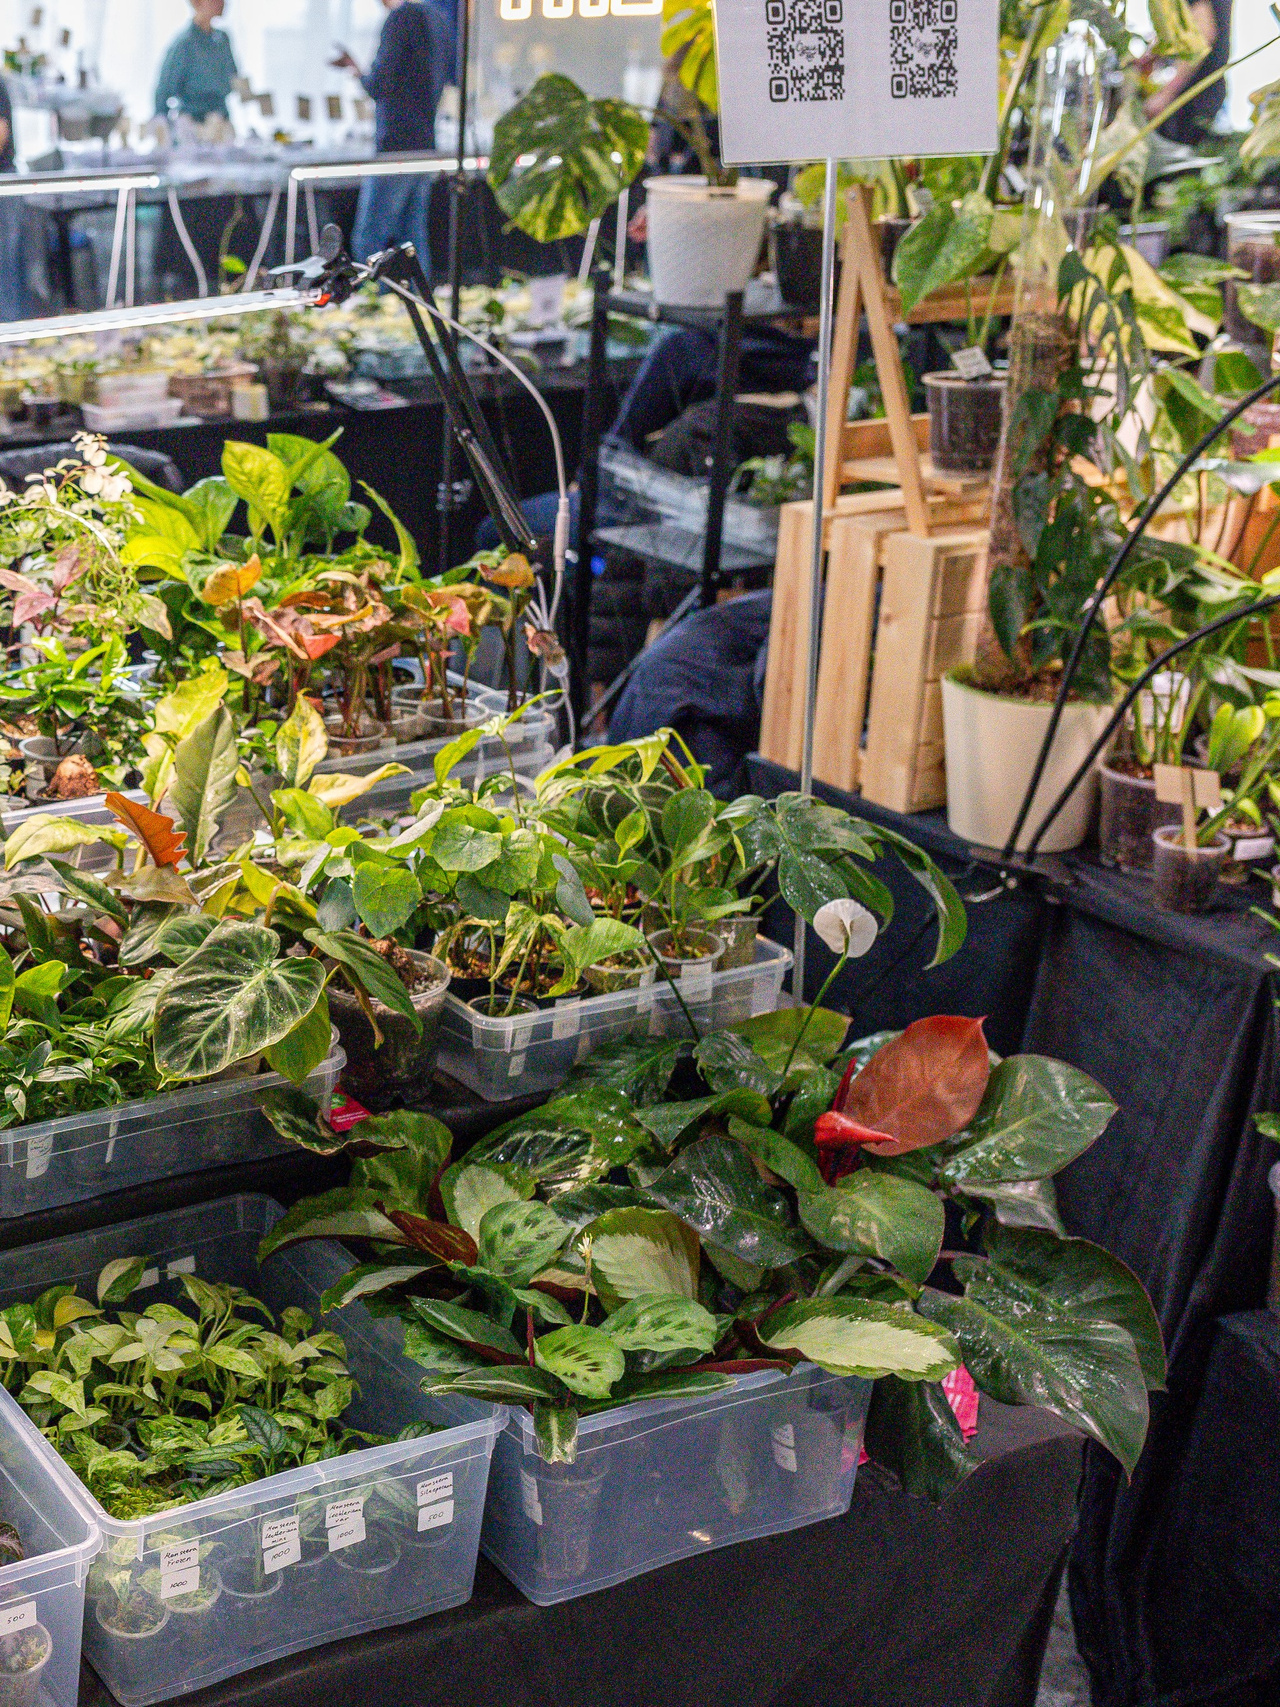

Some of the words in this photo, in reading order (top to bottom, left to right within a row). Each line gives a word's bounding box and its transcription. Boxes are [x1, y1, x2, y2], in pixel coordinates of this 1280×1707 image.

[428, 1511, 443, 1522] 500
[336, 1529, 354, 1540] 1000
[271, 1547, 290, 1561] 1000
[170, 1580, 188, 1589] 1000
[7, 1613, 25, 1624] 500
